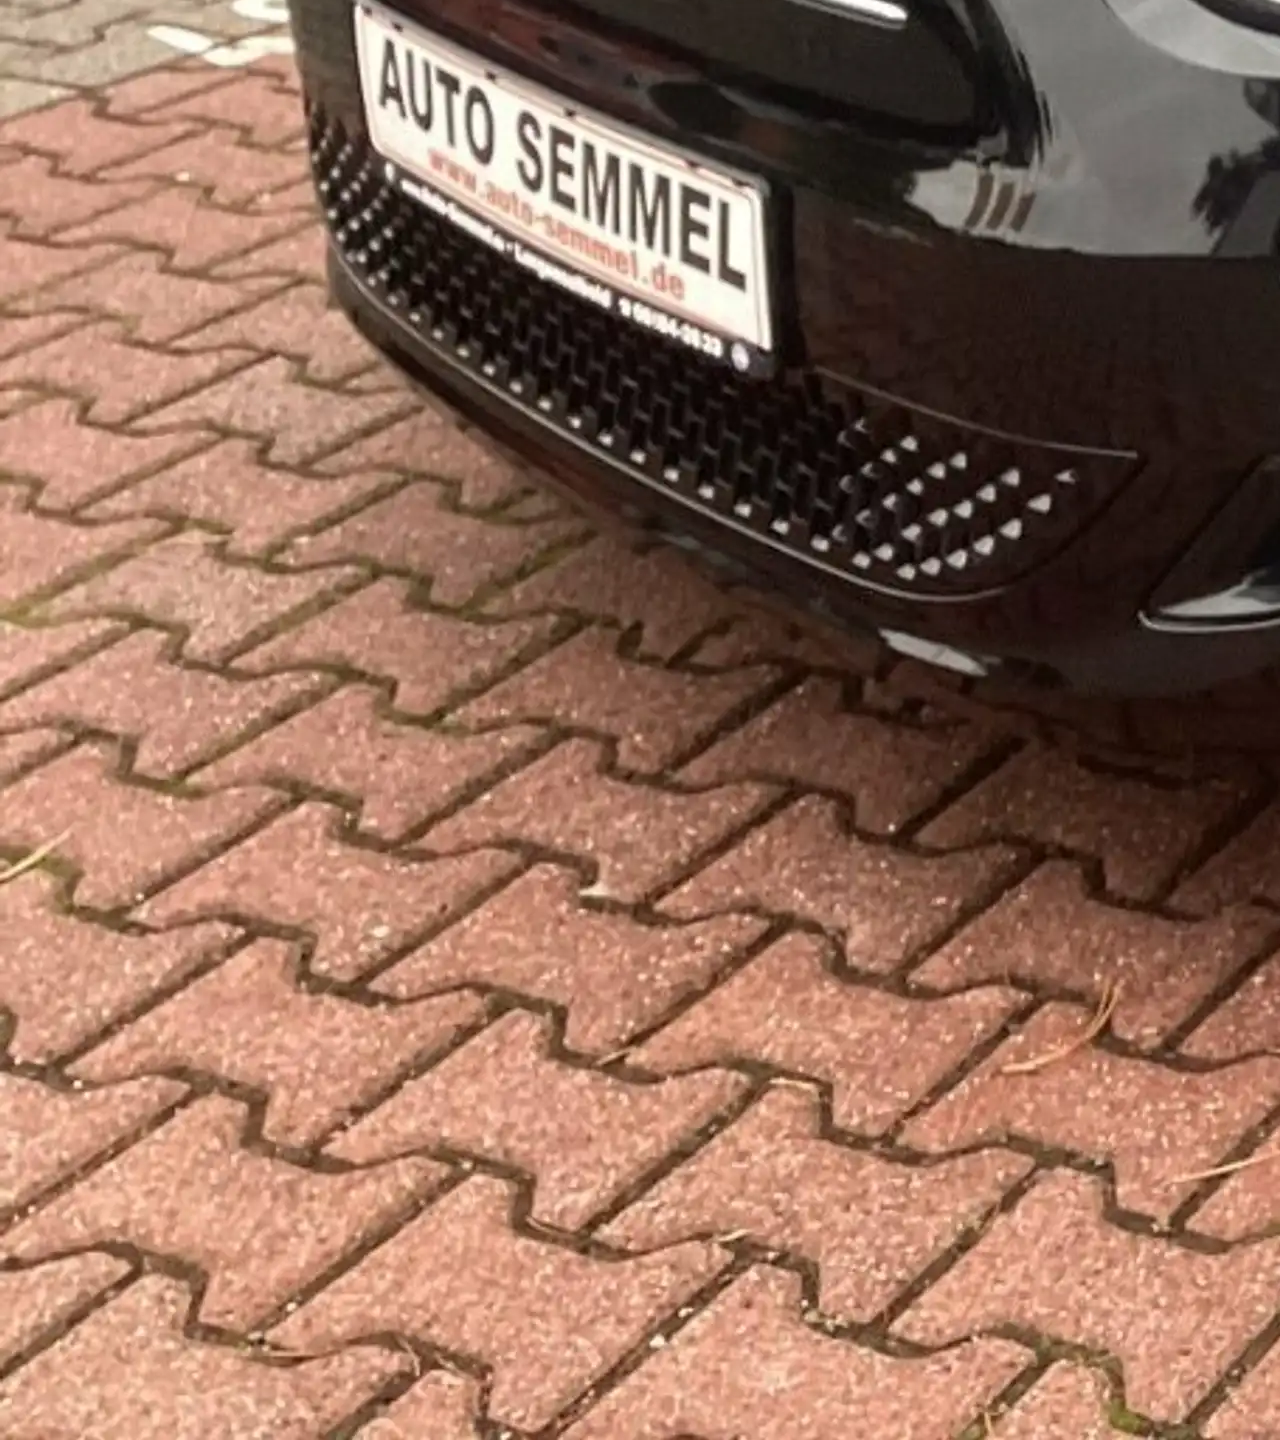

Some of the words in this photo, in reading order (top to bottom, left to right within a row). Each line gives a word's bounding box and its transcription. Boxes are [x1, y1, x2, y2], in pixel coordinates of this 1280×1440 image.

[378, 37, 495, 167] AUTO
[515, 109, 747, 292] SEMMEL
[427, 148, 686, 302] www.auto-semmel.de
